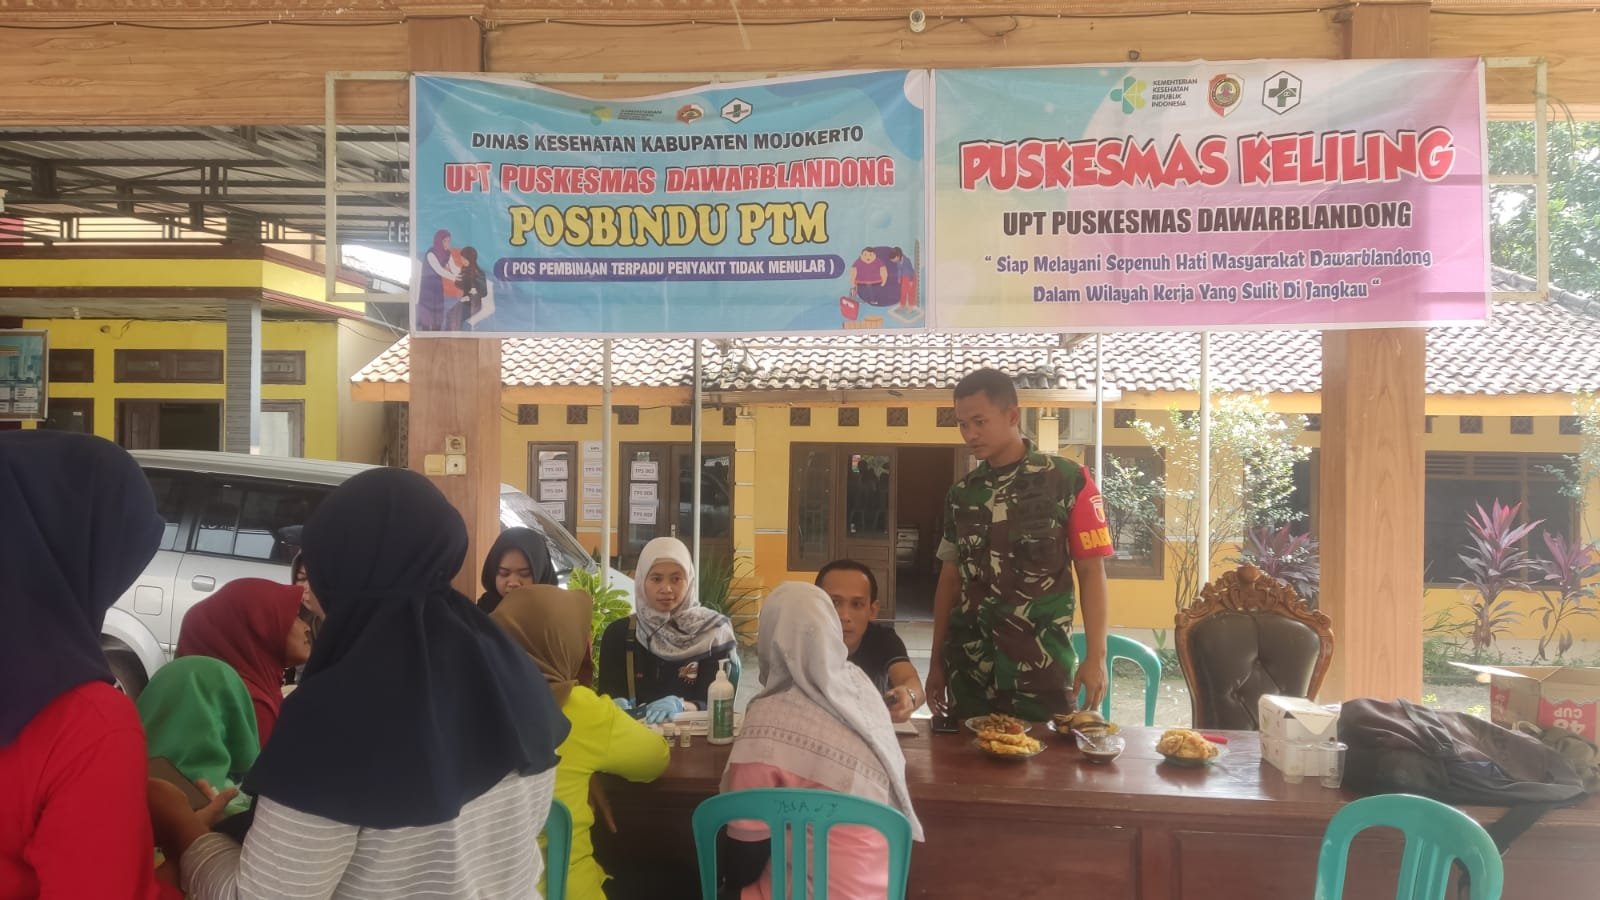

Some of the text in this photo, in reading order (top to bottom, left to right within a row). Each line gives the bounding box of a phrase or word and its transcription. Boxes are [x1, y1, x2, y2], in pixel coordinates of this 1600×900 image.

[472, 125, 864, 153] DINAS KESEHATAN KABUPATEN MOJOKERTO
[959, 127, 1457, 192] PUSKESMAS KELILING
[444, 155, 896, 195] UPT PUSKESMAS DAWARBLANDONG
[509, 201, 829, 246] POSBINDU PTM
[1002, 201, 1413, 236] UPT PUSKESMAS DAWARBLANDONG
[512, 261, 536, 276] POS
[539, 261, 608, 276] PEMBINAAN
[611, 261, 665, 276] TERPADU
[667, 260, 727, 275] PENYAKIT
[729, 260, 765, 275] TIDAK
[768, 259, 826, 274] MENULAR
[996, 255, 1029, 275] Siap
[1033, 255, 1101, 274] Melayani
[1106, 254, 1171, 273] Sepenuh
[1176, 252, 1207, 270] Hati
[1212, 252, 1305, 269] Masyarakat
[1310, 249, 1431, 267] Dawarblandong
[1033, 286, 1081, 302] Dalam
[1086, 284, 1149, 303] Wilayah
[1153, 284, 1195, 302] Kerja
[1199, 284, 1237, 301] Yang
[1242, 281, 1278, 299] Sulit
[1283, 281, 1301, 298] Di
[1305, 281, 1368, 300] Jangkau
[1554, 707, 1583, 718] CUP
